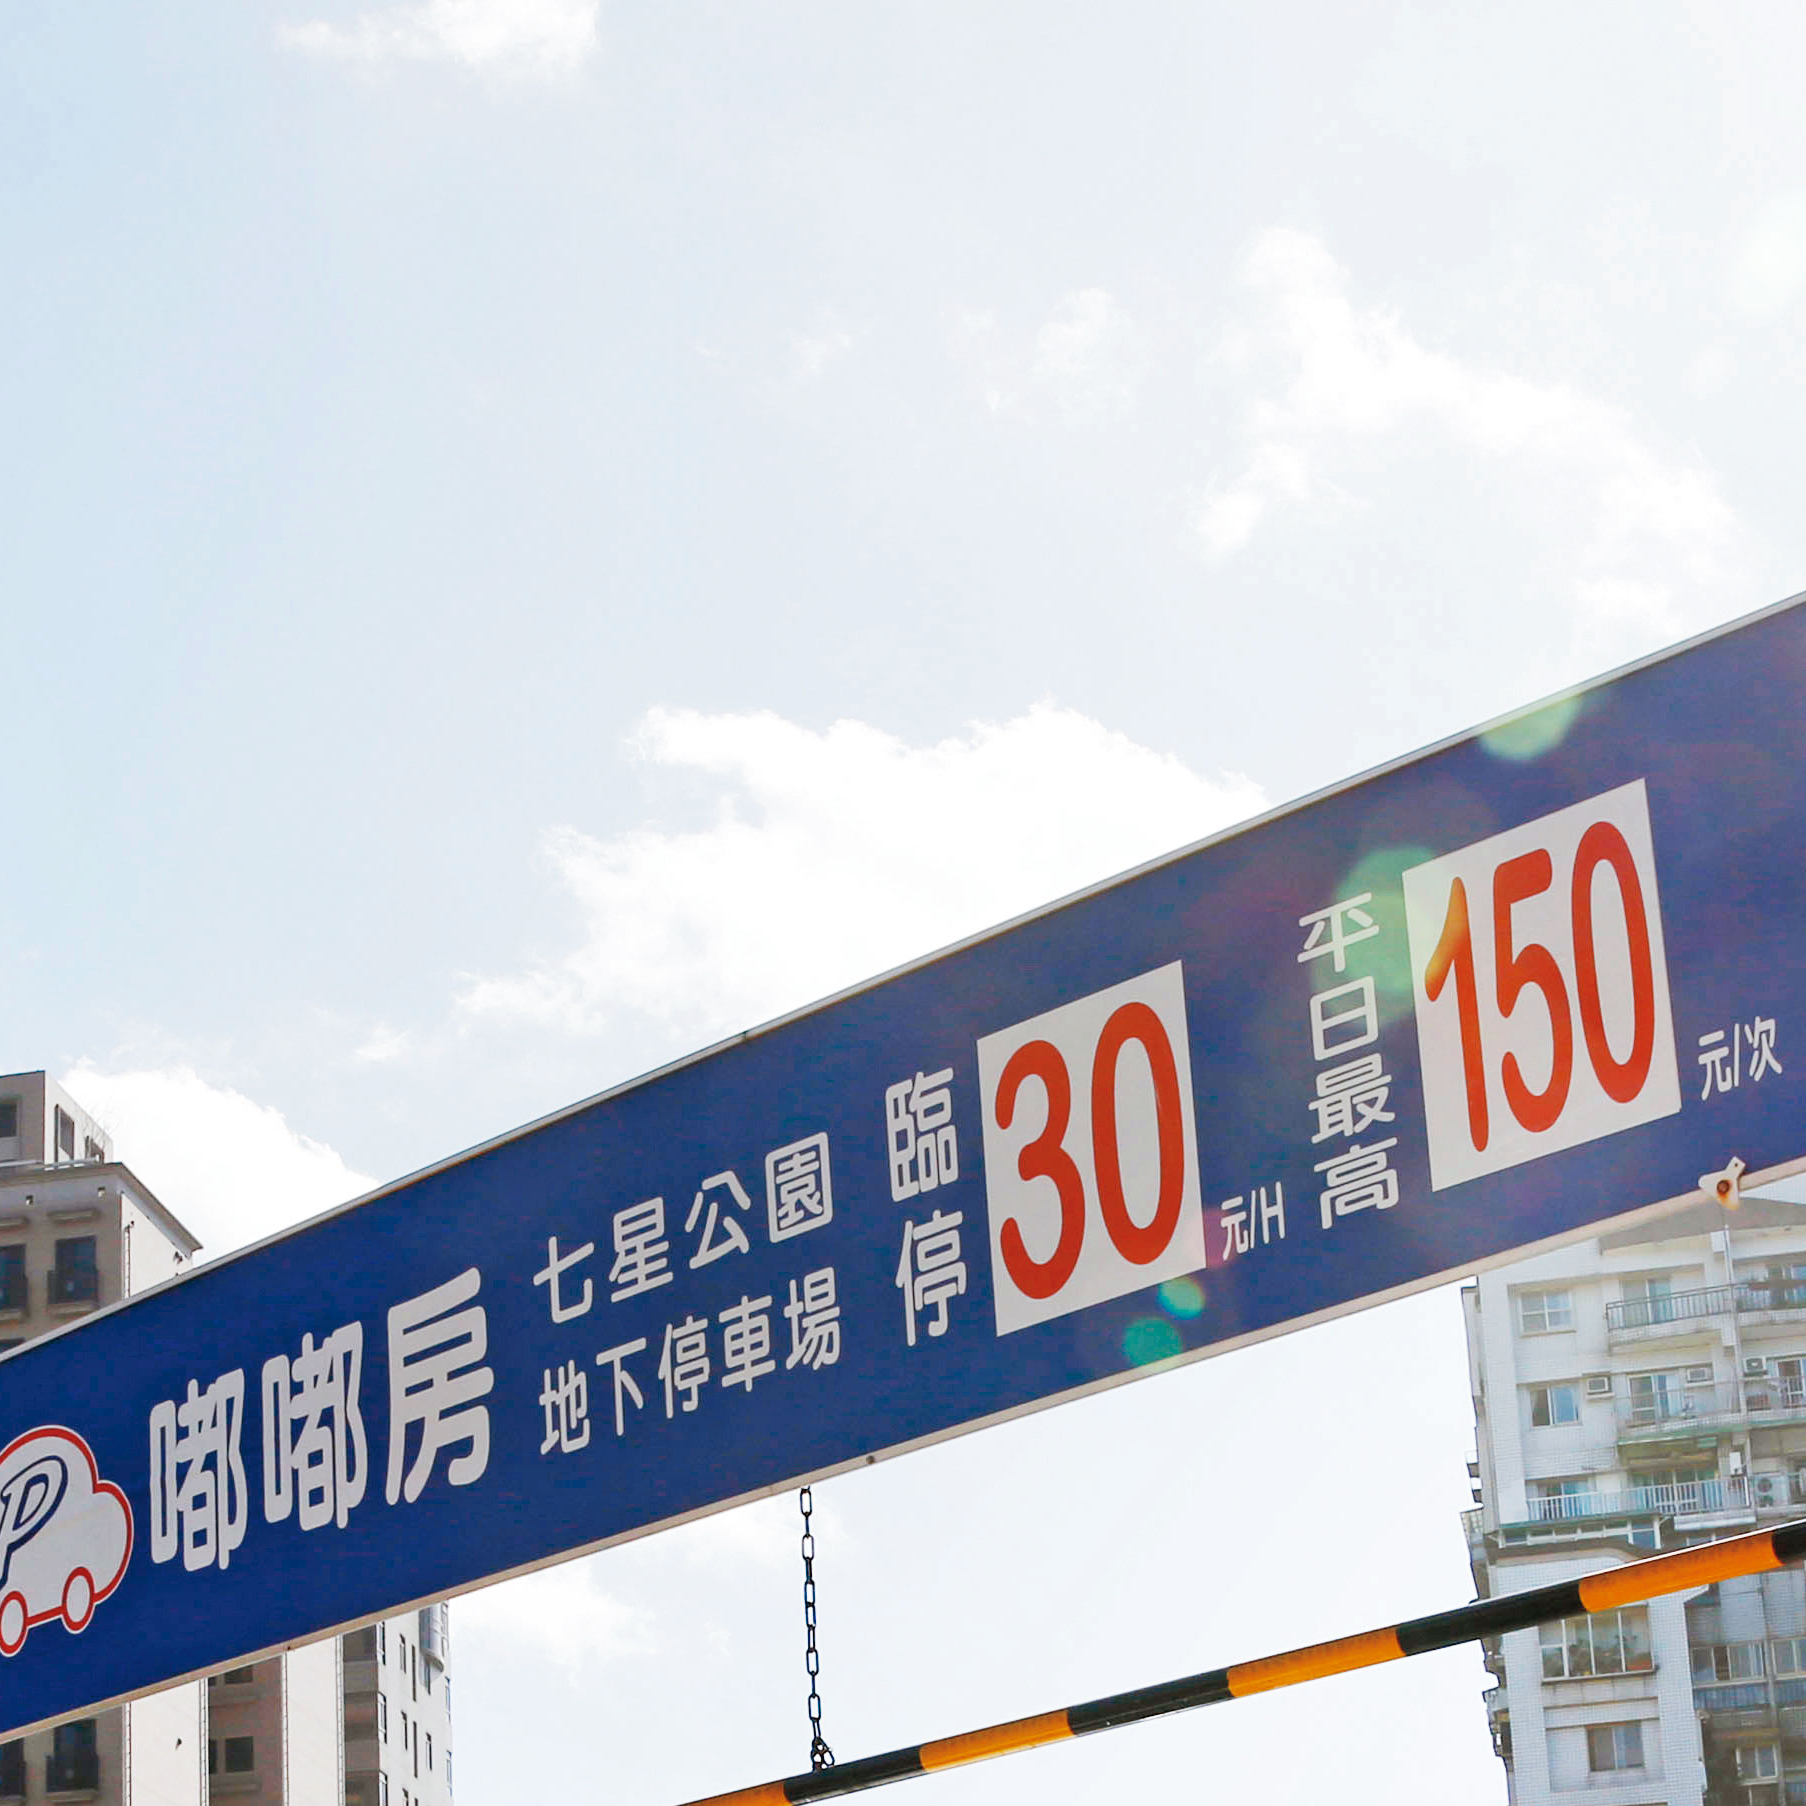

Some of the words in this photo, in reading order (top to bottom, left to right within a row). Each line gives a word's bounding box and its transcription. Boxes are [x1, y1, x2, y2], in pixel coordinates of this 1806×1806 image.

[1297, 892, 1399, 1229] 平日最高
[1425, 821, 1655, 1152] 150
[1698, 1016, 1783, 1100] 元/次
[532, 1132, 833, 1325] 七星公園
[885, 1067, 967, 1346] 臨停
[994, 1002, 1185, 1299] 30
[1219, 1181, 1287, 1261] 元/H
[149, 1267, 494, 1571] 嘟嘟房
[538, 1266, 841, 1456] 地下停車場
